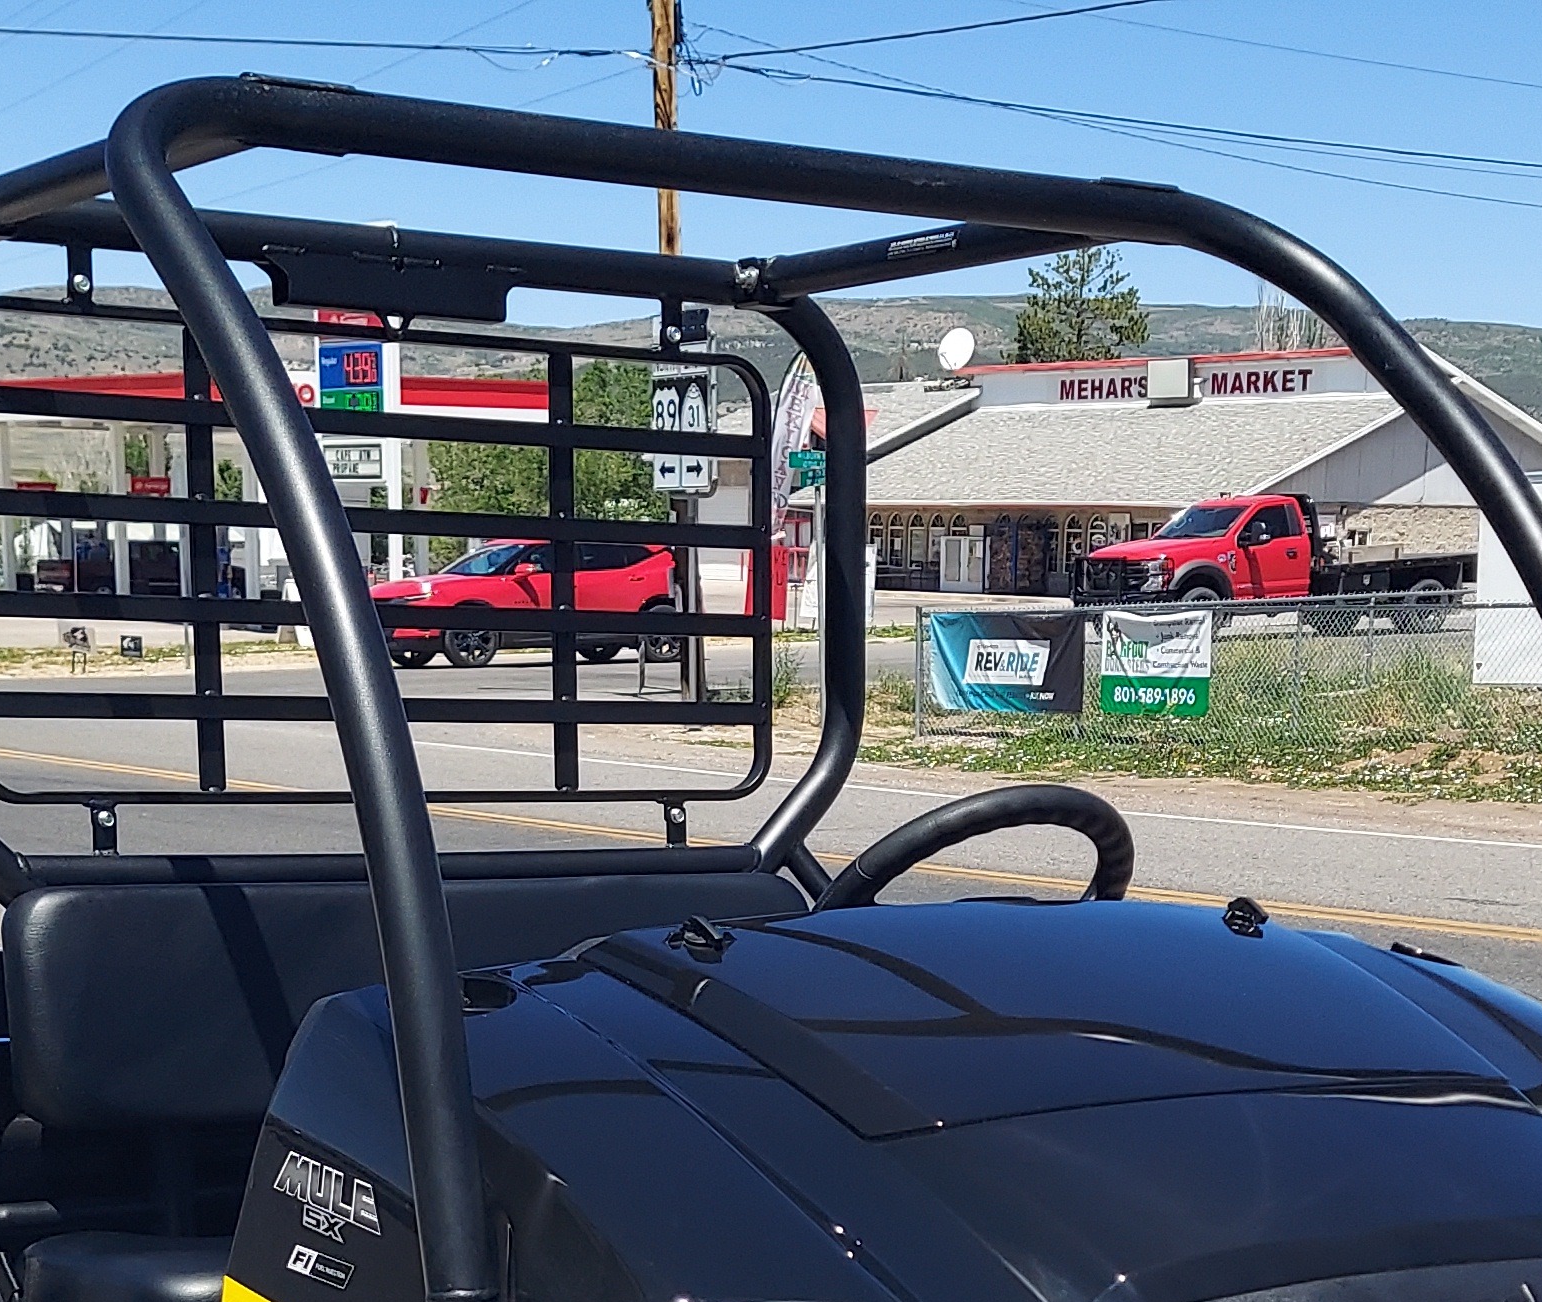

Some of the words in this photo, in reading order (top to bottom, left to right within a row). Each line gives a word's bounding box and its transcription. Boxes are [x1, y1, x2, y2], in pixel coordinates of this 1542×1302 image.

[1059, 376, 1148, 401] MEHAR'S
[1210, 369, 1313, 395] MARKET
[687, 404, 701, 428] 31
[1113, 685, 1196, 706] 801-589-1896
[273, 1150, 381, 1237] MULE
